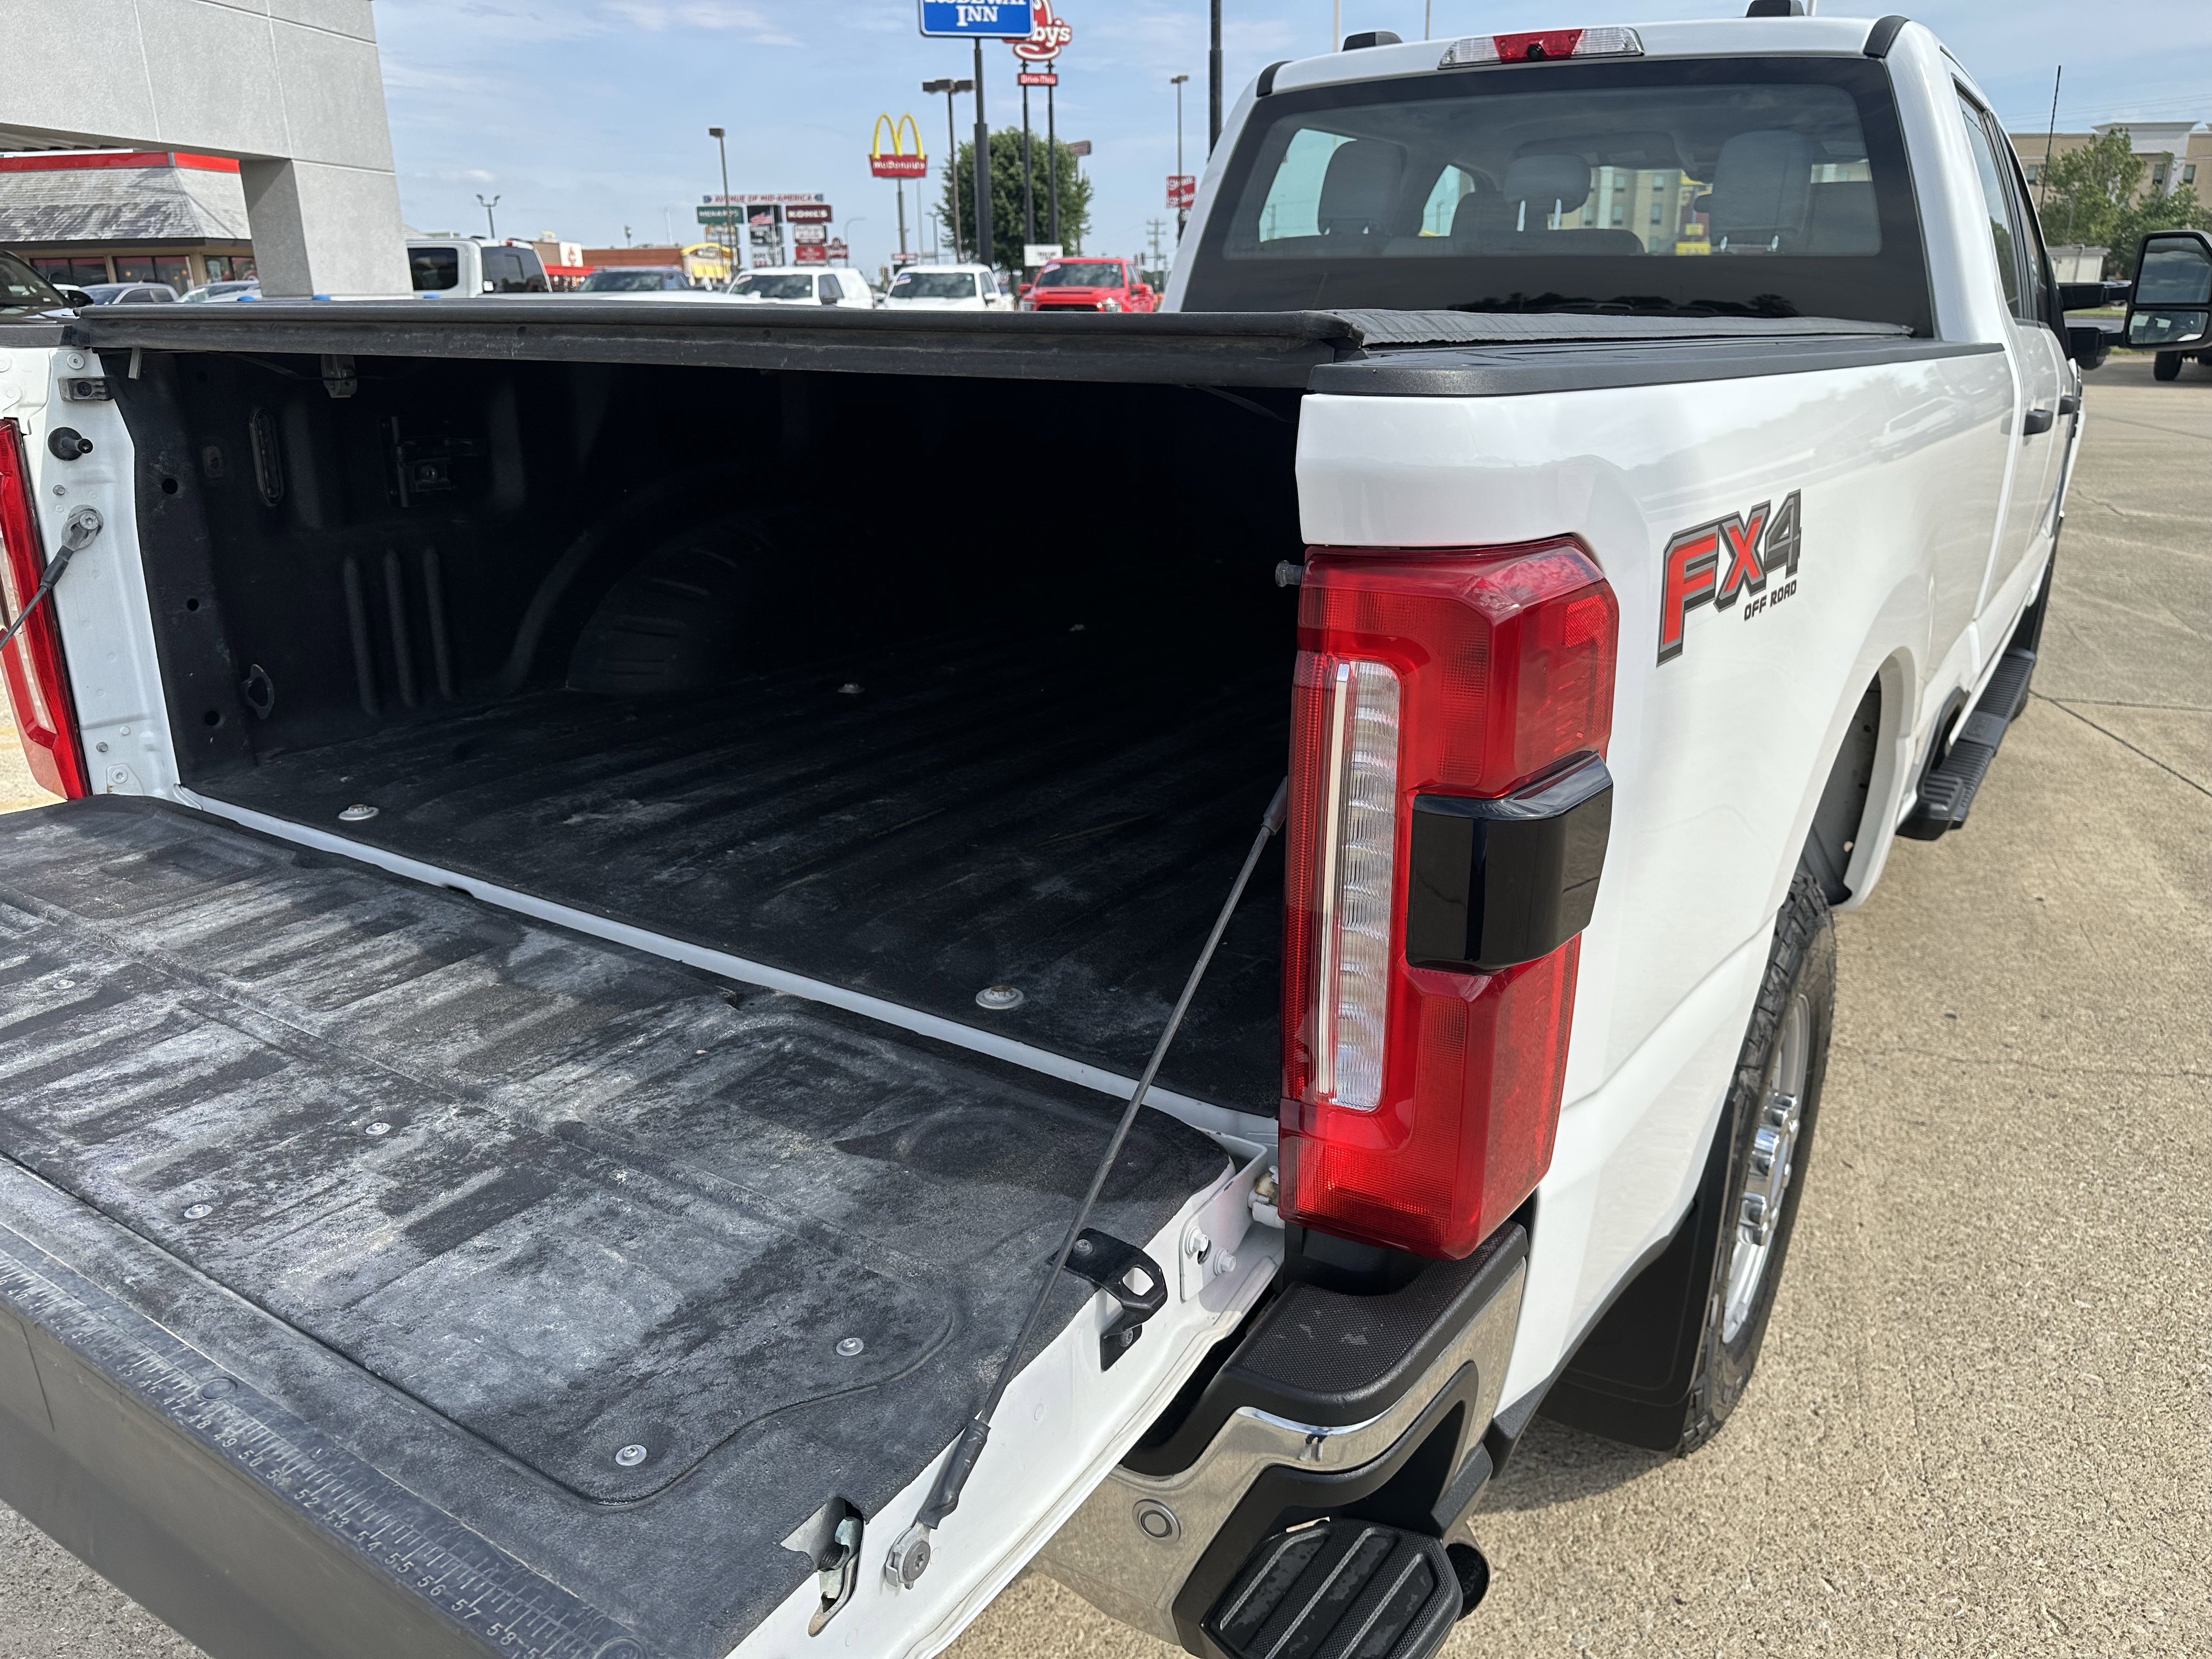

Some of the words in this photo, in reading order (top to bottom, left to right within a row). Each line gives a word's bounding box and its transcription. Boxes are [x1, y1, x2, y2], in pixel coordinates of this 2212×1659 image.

[956, 5, 998, 26] INN
[1027, 18, 1072, 48] by's
[1656, 488, 1802, 668] FX4
[1743, 595, 1767, 621] OFF
[1770, 579, 1797, 607] ROAD
[213, 1433, 238, 1447] 49
[239, 1449, 264, 1467] 50
[294, 1488, 320, 1508] 52
[323, 1509, 350, 1528] 53
[354, 1530, 382, 1551] 54
[385, 1552, 415, 1573] 55
[417, 1575, 447, 1596] 56
[452, 1599, 482, 1619] 57
[487, 1622, 517, 1646] 58
